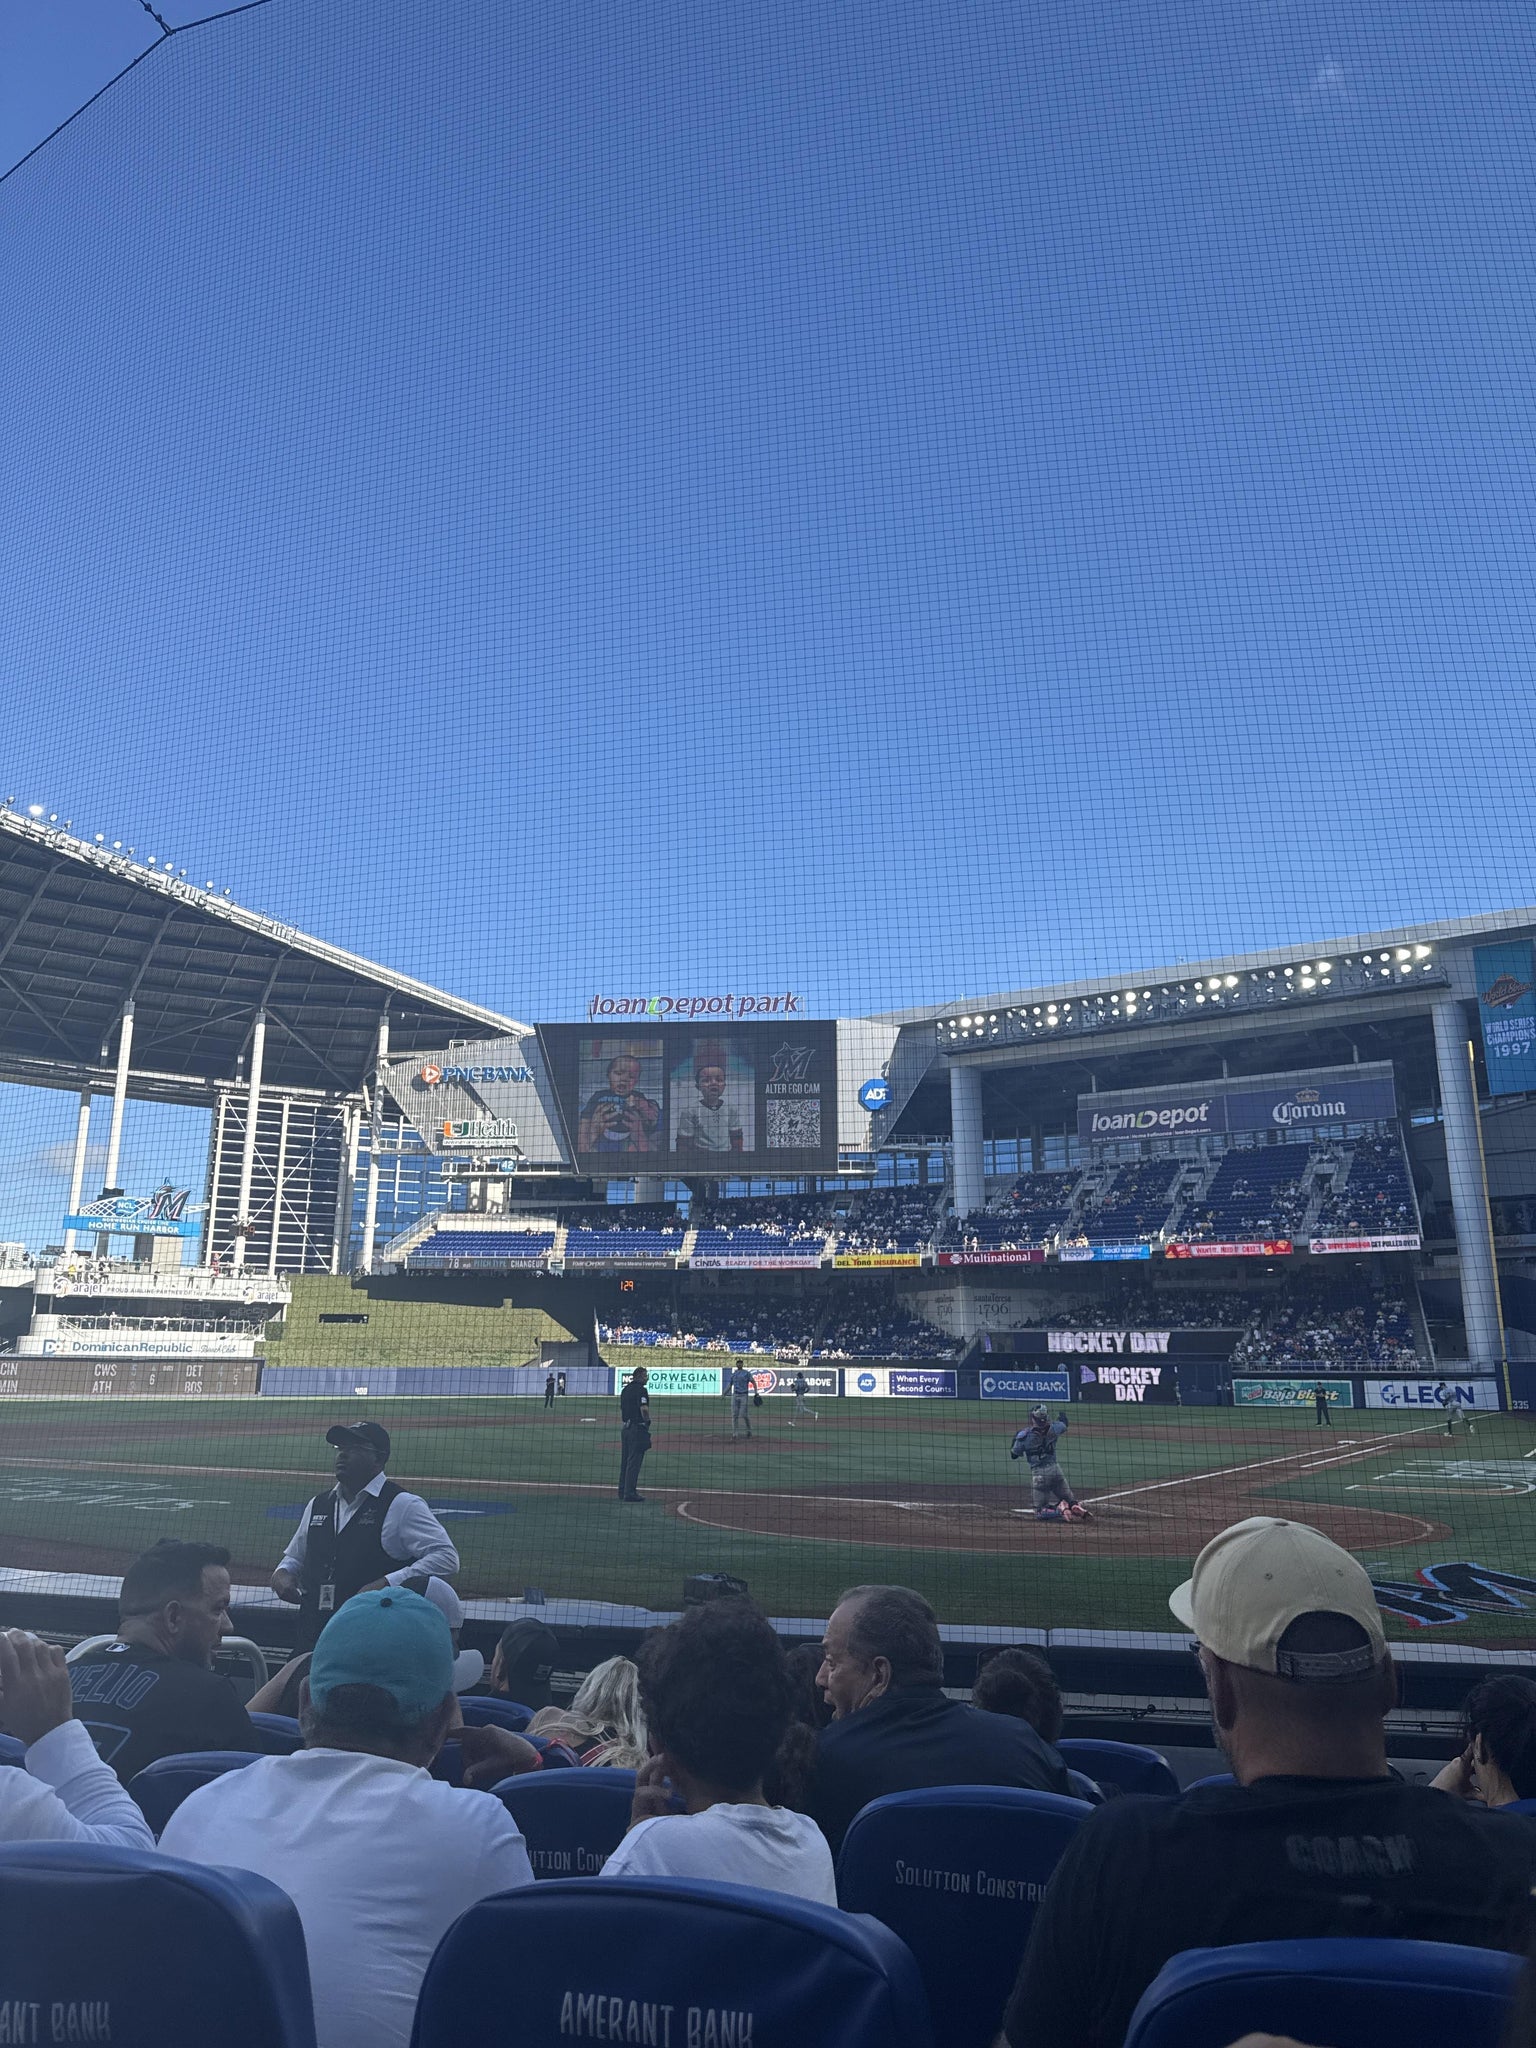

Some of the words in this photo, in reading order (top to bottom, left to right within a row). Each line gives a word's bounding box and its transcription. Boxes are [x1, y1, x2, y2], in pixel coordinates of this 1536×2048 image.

[592, 993, 735, 1019] loanDepot
[738, 991, 799, 1018] park
[1484, 1019, 1509, 1034] WORLD
[1509, 1016, 1535, 1031] SERIES
[1486, 1027, 1536, 1046] CHAMPIONS
[1493, 1041, 1532, 1058] 1997
[765, 1083, 787, 1094] ALTER
[788, 1084, 803, 1094] EGO
[803, 1083, 821, 1094] CAM
[864, 1087, 887, 1101] ADT
[1091, 1101, 1210, 1133] loanDepot
[1272, 1100, 1347, 1125] Corona
[501, 1160, 514, 1170] 42
[117, 1202, 134, 1210] NCL
[88, 1222, 117, 1230] HOME
[120, 1223, 140, 1231] RUN
[143, 1224, 180, 1233] HARBOR
[448, 1259, 460, 1268] 78
[510, 1260, 545, 1268] CHANGEUP
[964, 1252, 1031, 1263] Multinational
[73, 1283, 102, 1294] arajet
[257, 1291, 278, 1300] arajet
[978, 1303, 1009, 1318] 1796
[1047, 1332, 1126, 1352] HOCKEY
[1129, 1332, 1171, 1353] DAY
[0, 1362, 18, 1376] CIN
[94, 1363, 117, 1377] CWS
[186, 1365, 203, 1377] DET
[1098, 1367, 1162, 1384] HOCKEY
[149, 1374, 156, 1385] 6
[646, 1373, 717, 1382] ORWEGIAN
[860, 1379, 874, 1387] ADT
[896, 1375, 917, 1383] When
[92, 1381, 111, 1393] ATH
[184, 1381, 203, 1393] BOS
[896, 1384, 923, 1392] Second
[998, 1379, 1034, 1392] OCEAN
[1036, 1381, 1066, 1392] BANK
[1115, 1384, 1146, 1401] DAY
[1262, 1389, 1295, 1402] Baja
[1512, 1400, 1530, 1410] 335
[51, 2001, 112, 2043] BANK
[560, 1991, 674, 2048] AMERANT
[686, 2006, 753, 2048] BANK
